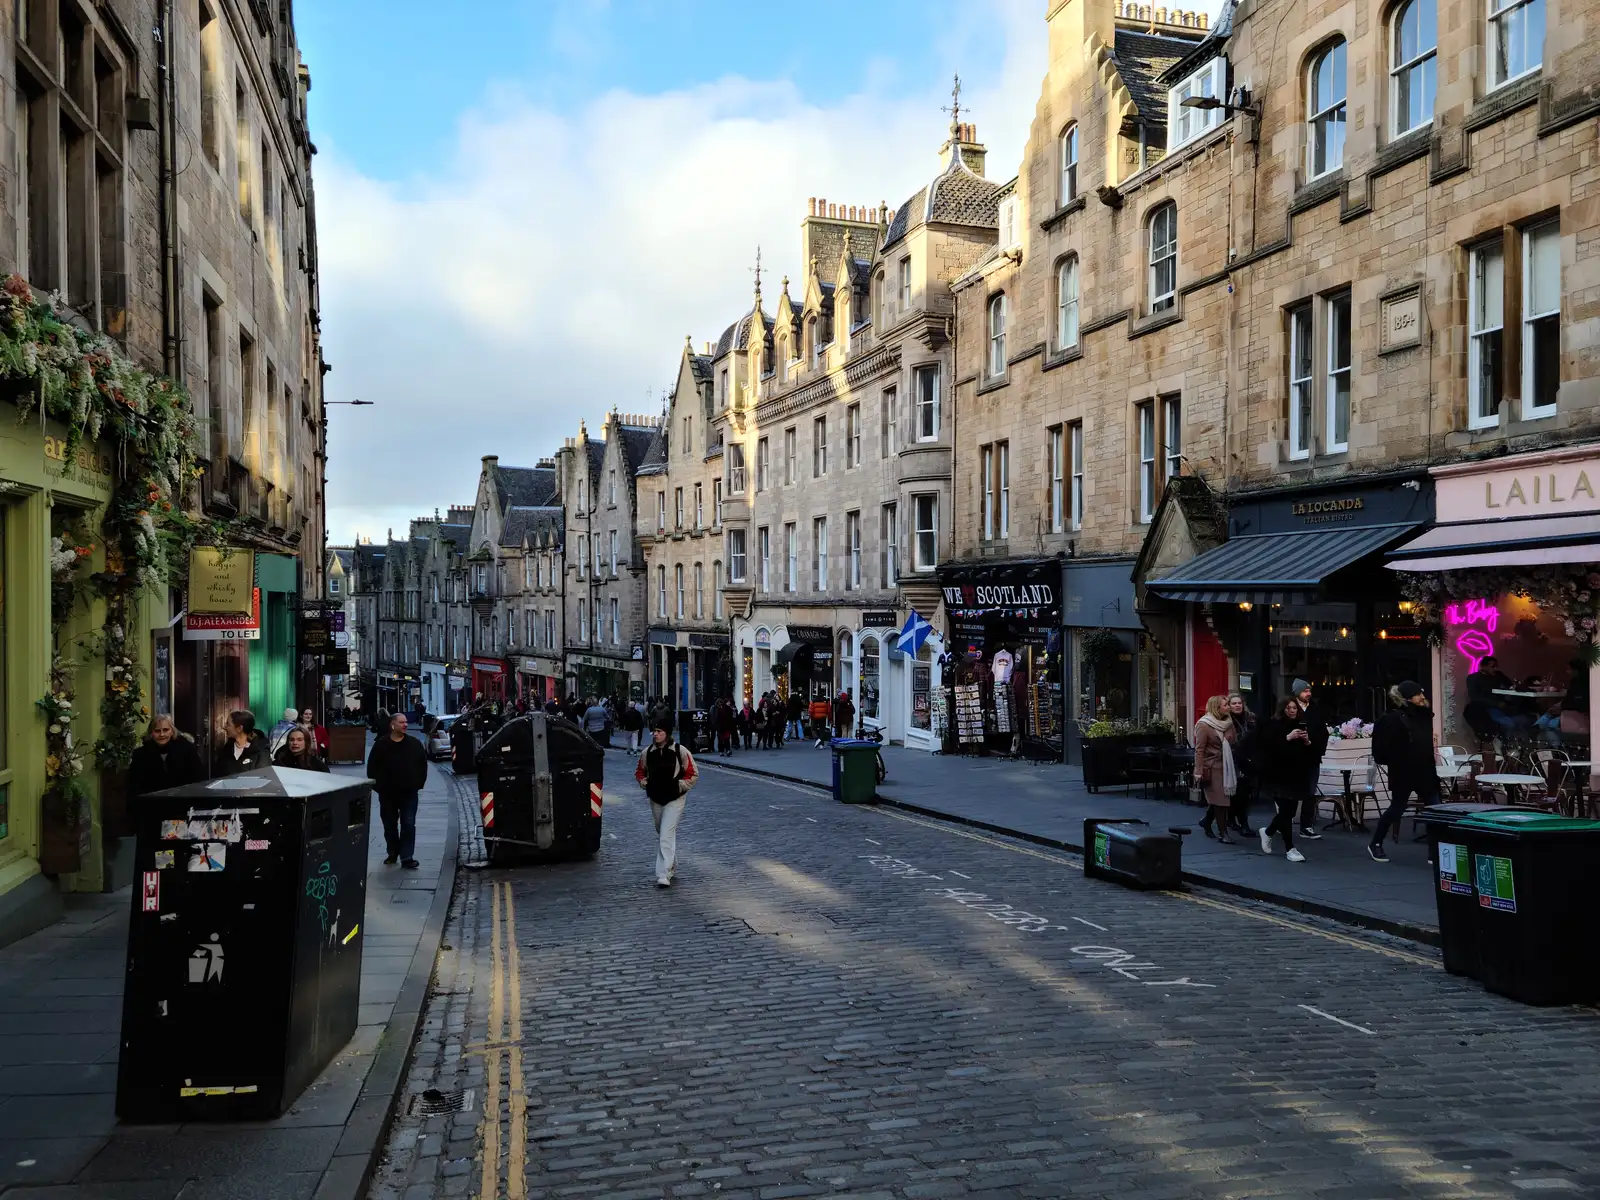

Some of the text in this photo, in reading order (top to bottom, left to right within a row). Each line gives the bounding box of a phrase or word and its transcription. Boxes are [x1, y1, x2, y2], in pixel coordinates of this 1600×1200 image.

[44, 435, 110, 476] arade
[1485, 470, 1595, 508] LAILA
[1292, 497, 1364, 515] LA LOCANDA
[208, 560, 236, 571] haggis
[206, 583, 236, 595] whisky
[209, 594, 233, 603] house
[942, 586, 963, 605] WE
[976, 584, 1053, 605] SCOTLAND
[221, 630, 257, 639] TO LET
[924, 887, 1069, 932] HOLDERS
[1069, 945, 1216, 988] ONLY
